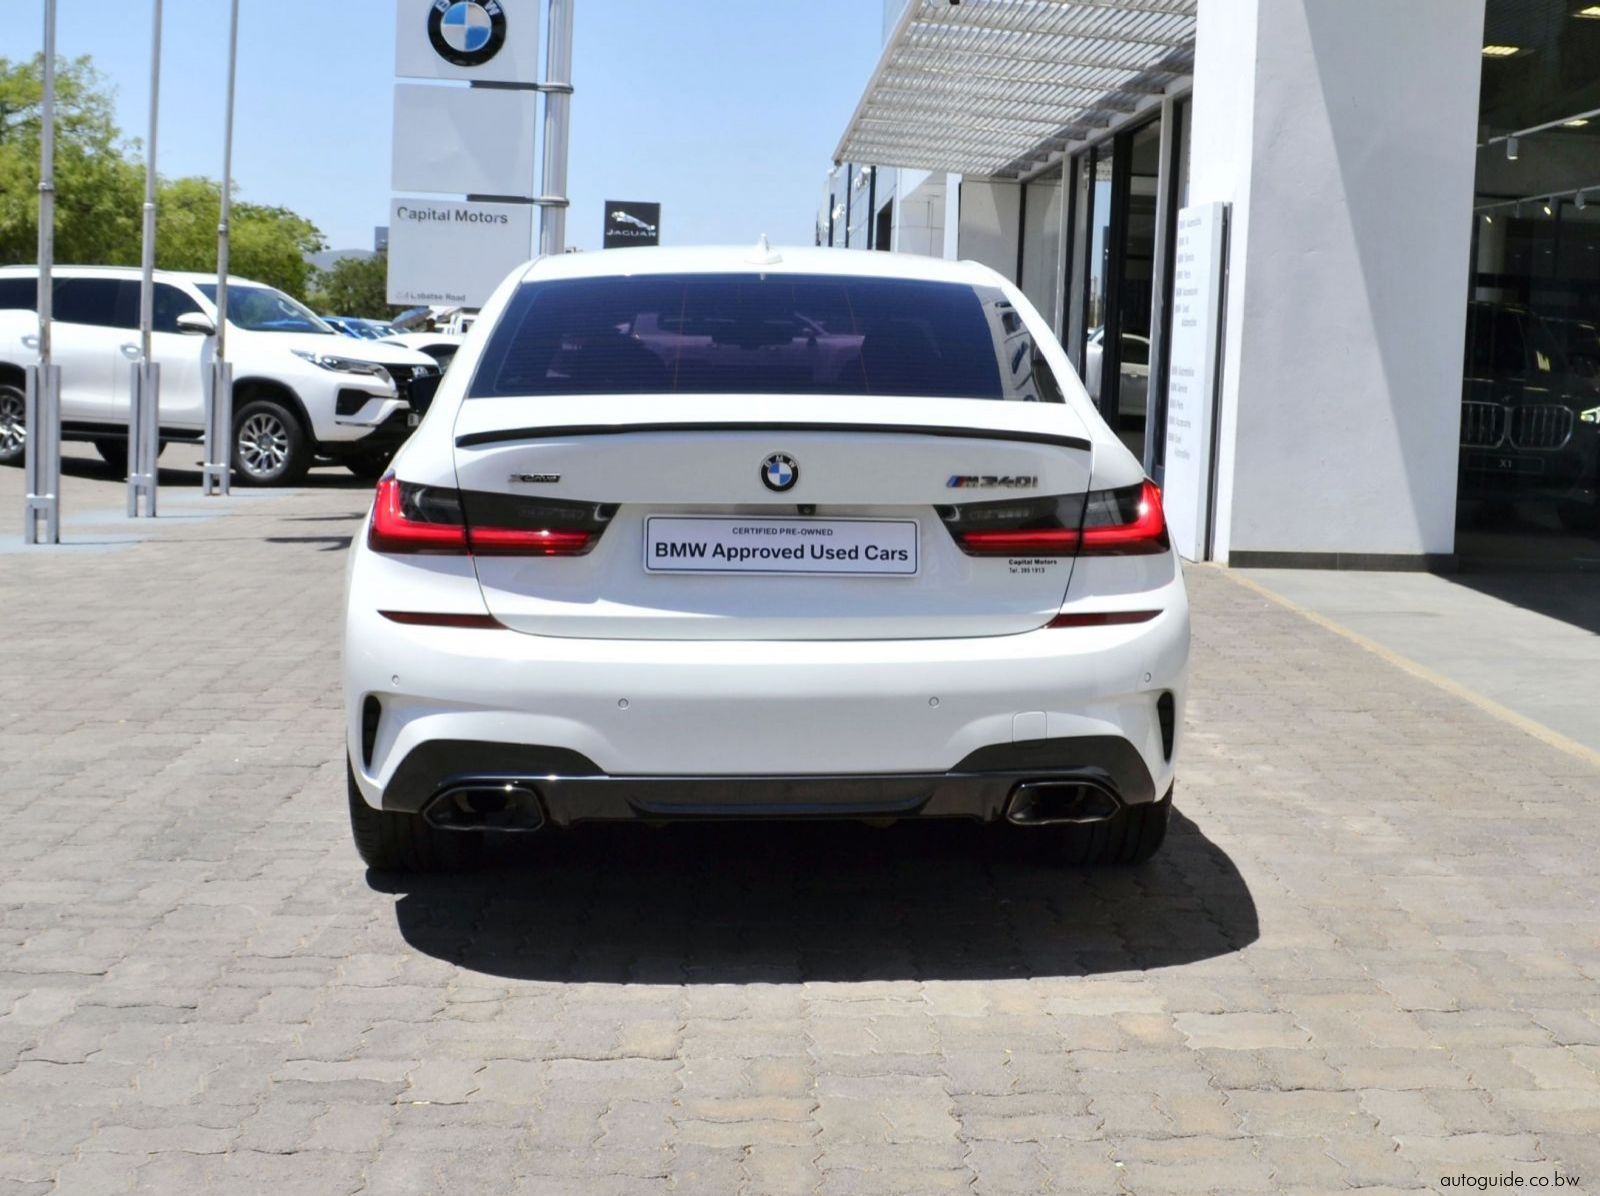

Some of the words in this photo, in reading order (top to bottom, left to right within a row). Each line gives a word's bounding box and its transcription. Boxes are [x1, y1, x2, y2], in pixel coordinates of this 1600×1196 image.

[397, 206, 450, 222] Capital
[455, 209, 508, 224] Motors
[606, 229, 656, 237] JAGUAR
[1498, 458, 1512, 468] X1
[732, 527, 778, 535] CERTIFIED
[779, 528, 833, 536] PRE-OWNED
[655, 542, 707, 558] BMW
[711, 543, 804, 562] Approved
[810, 544, 859, 560] Used
[864, 545, 908, 561] Cars
